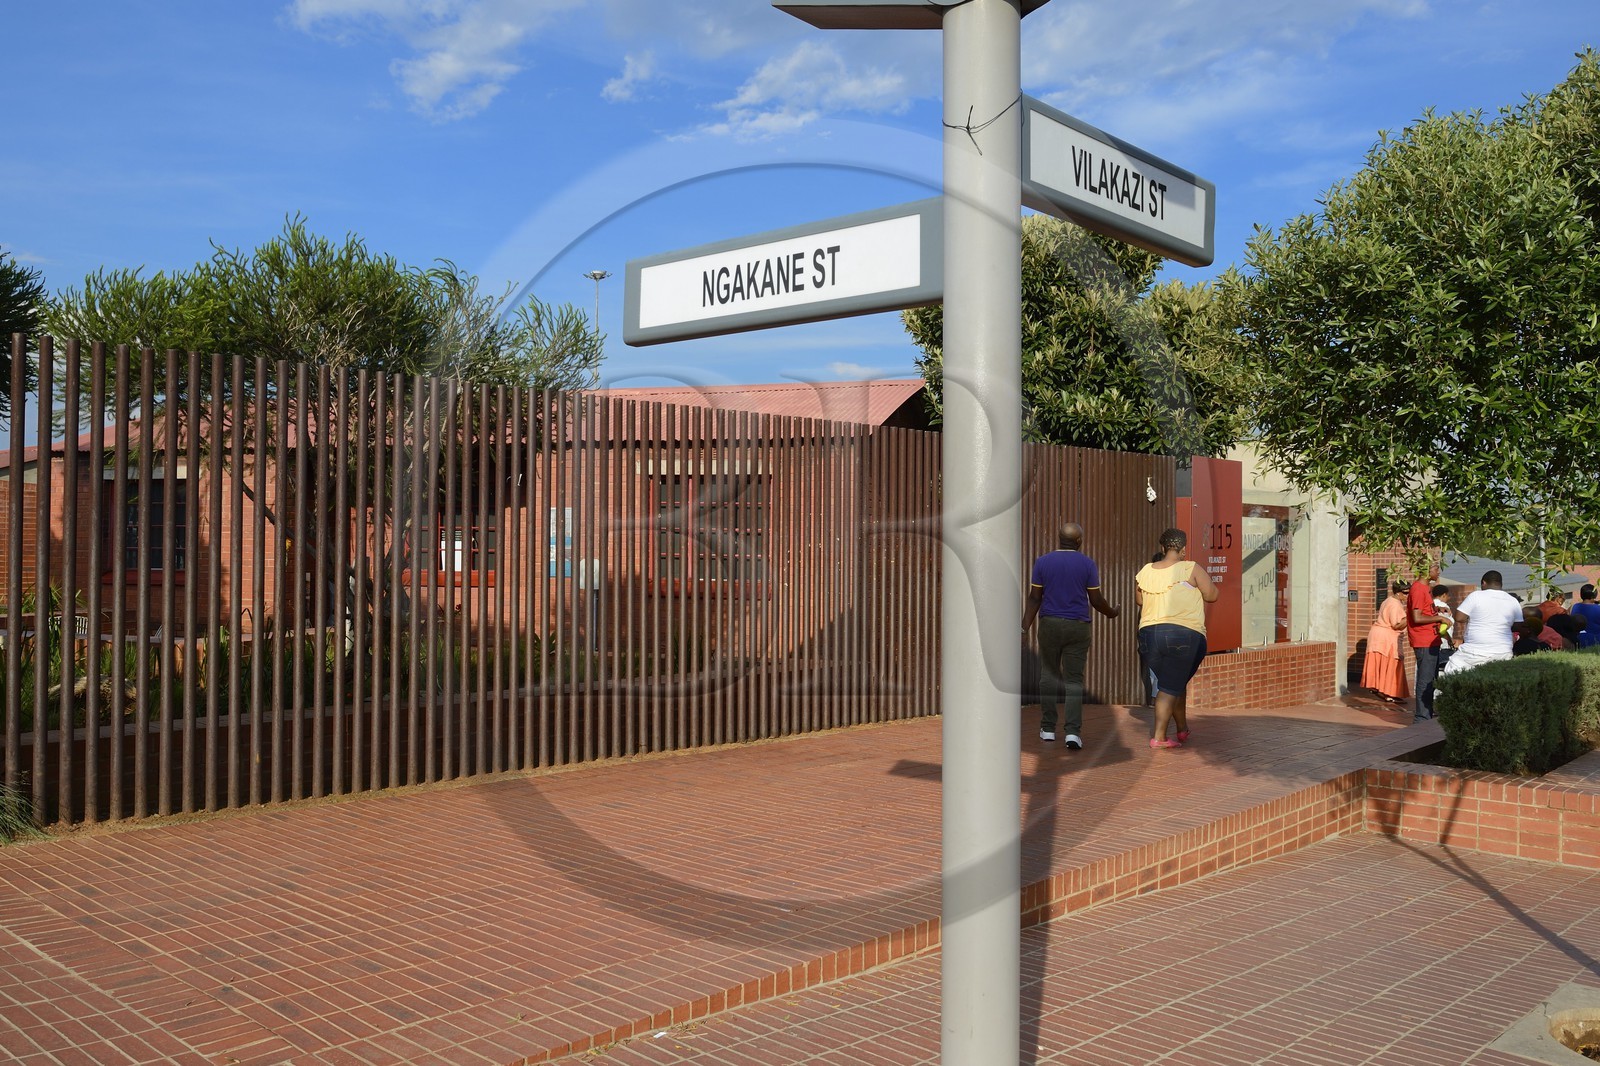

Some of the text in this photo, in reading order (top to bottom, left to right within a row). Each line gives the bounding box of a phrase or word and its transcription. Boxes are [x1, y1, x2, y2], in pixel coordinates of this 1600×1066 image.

[1071, 145, 1167, 220] VILAKAZI ST
[702, 245, 841, 307] NGAKANE ST
[1242, 533, 1271, 551] ANDELA
